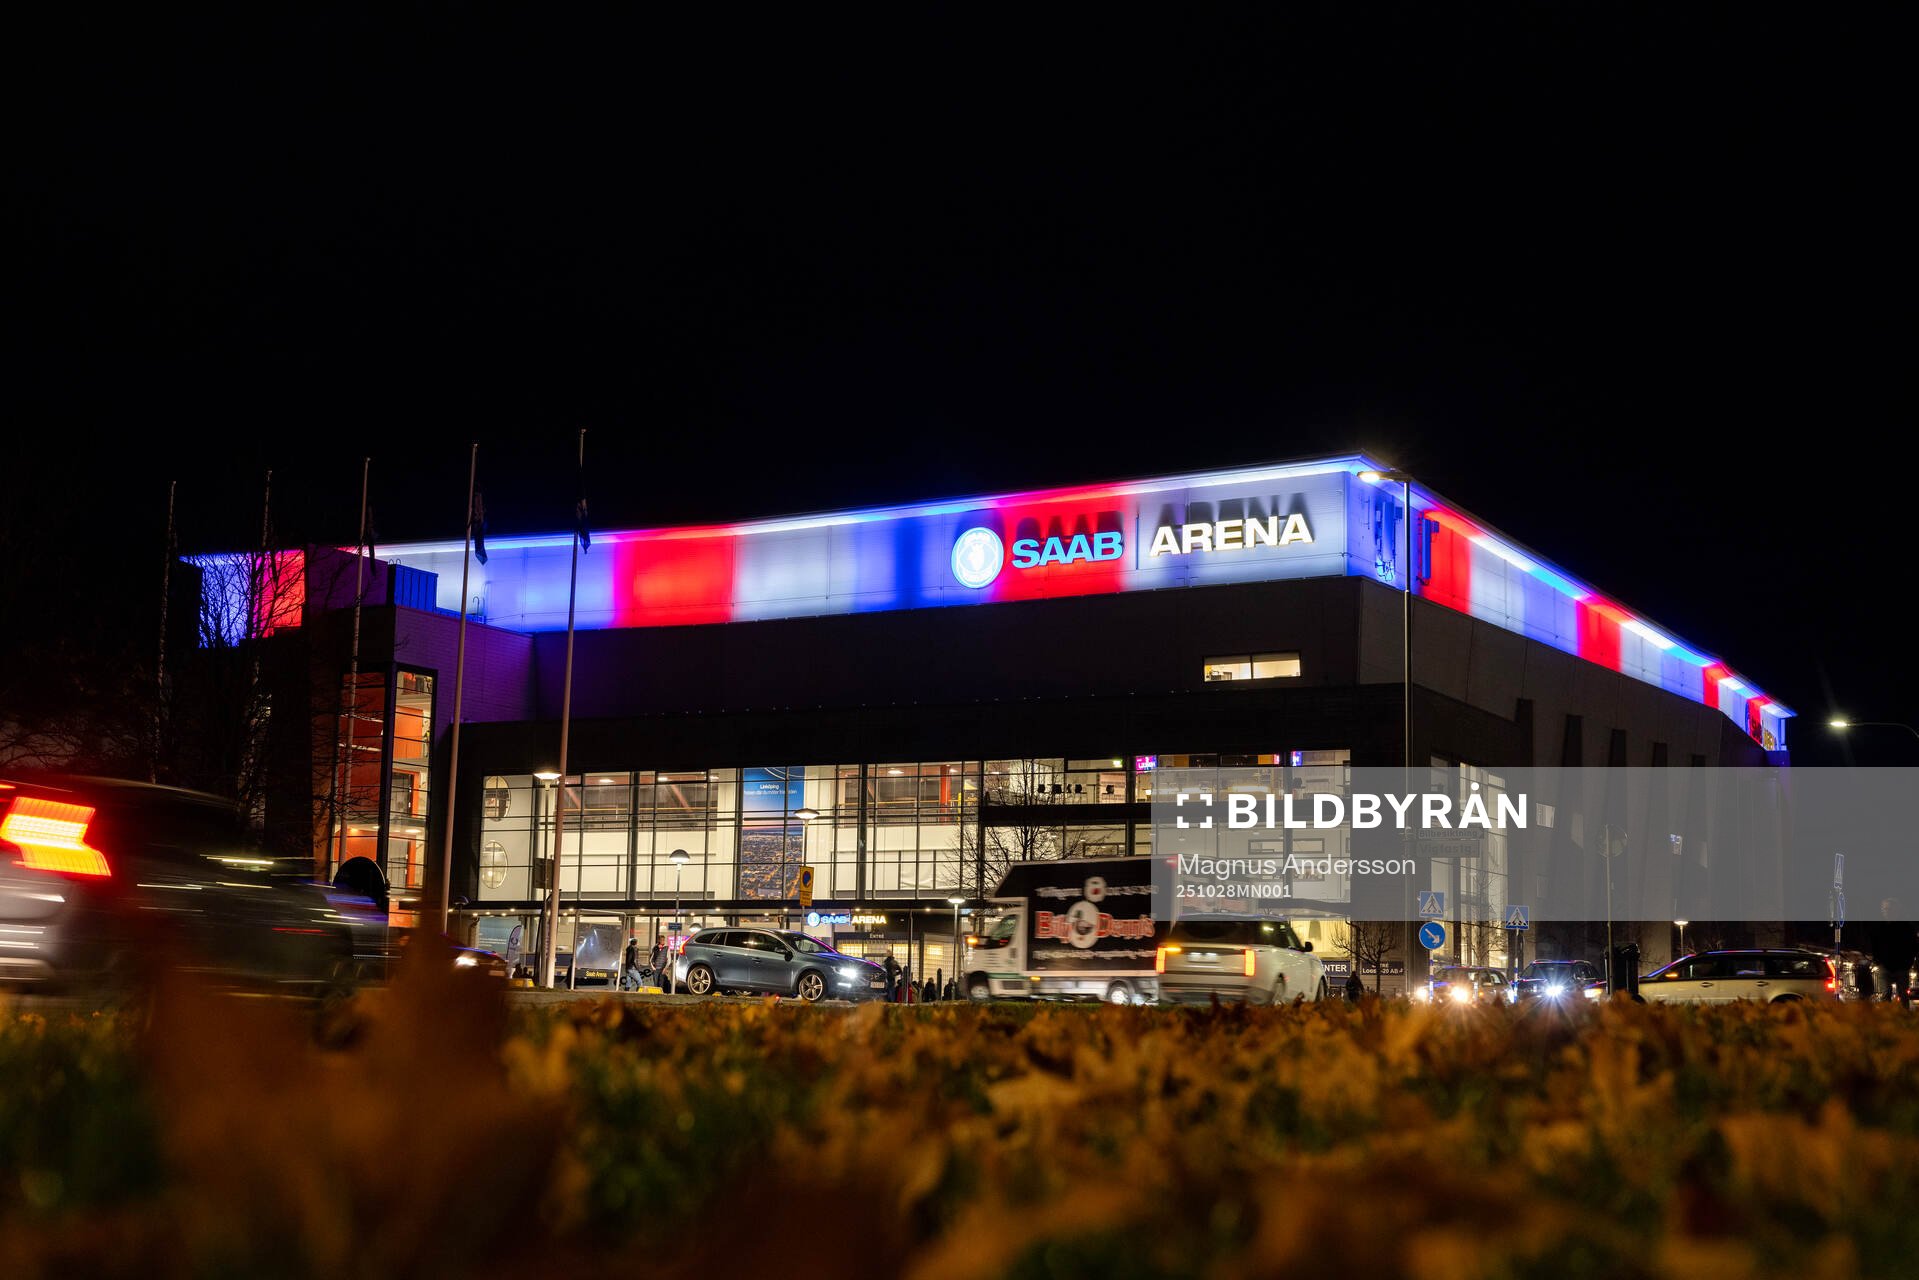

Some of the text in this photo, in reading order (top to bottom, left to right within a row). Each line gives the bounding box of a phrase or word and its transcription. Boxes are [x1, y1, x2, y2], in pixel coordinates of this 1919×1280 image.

[1012, 513, 1313, 569] SAAB ARENA
[820, 915, 888, 925] SAAB ARENA
